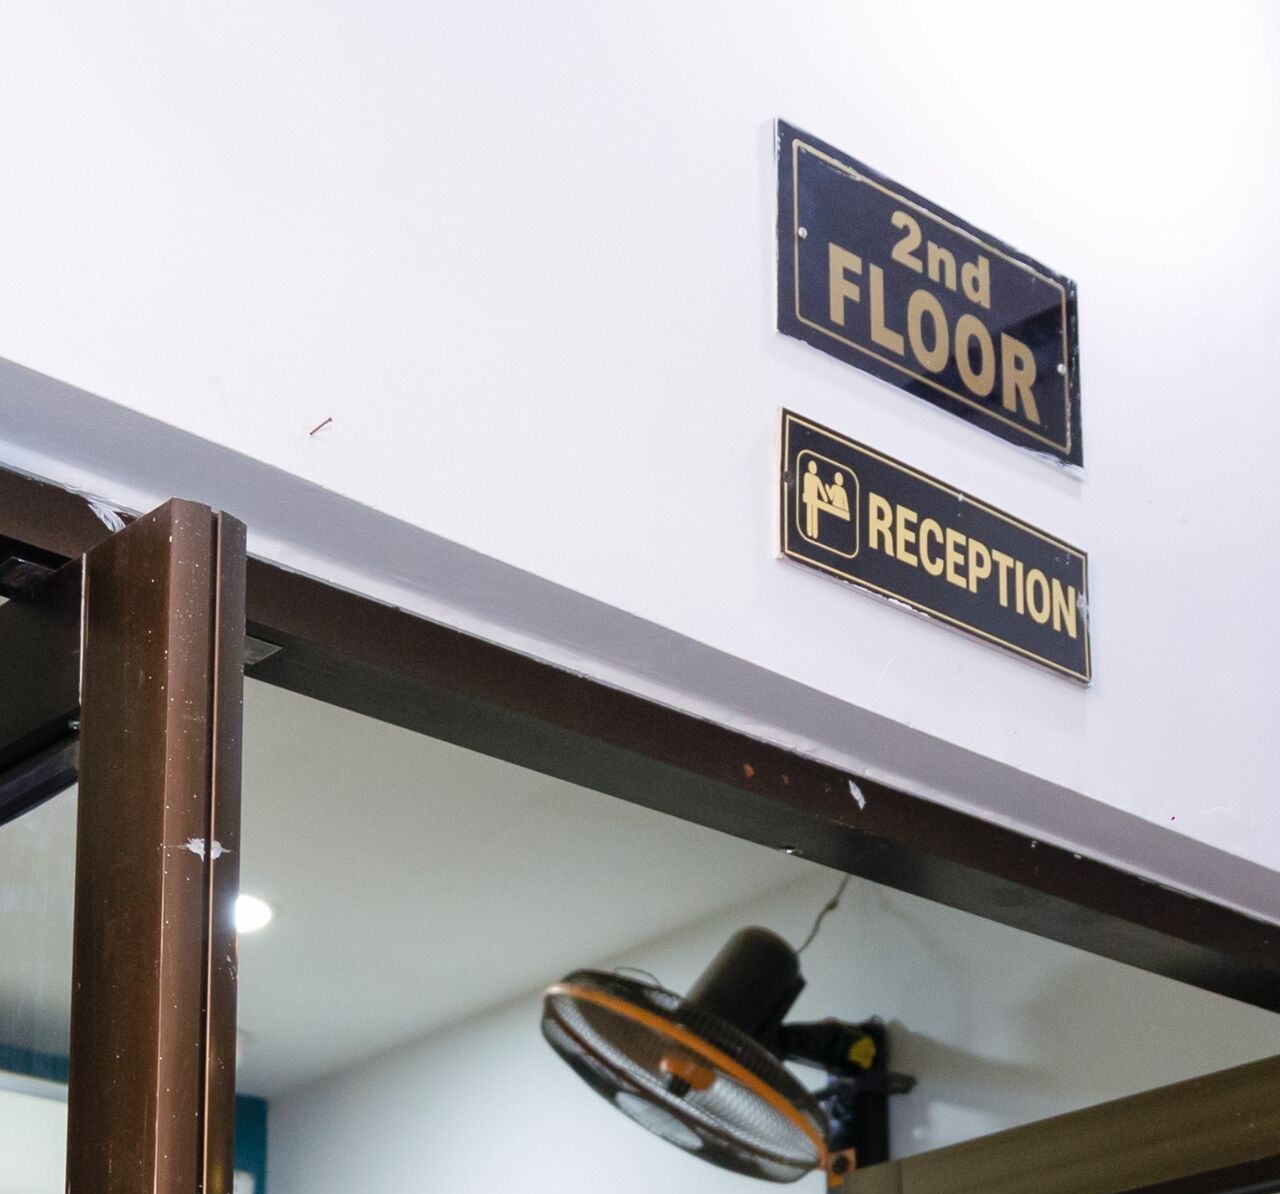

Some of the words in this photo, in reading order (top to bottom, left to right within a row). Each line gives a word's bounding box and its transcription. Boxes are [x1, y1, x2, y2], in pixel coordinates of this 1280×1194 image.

[828, 241, 1040, 425] FLOOR
[890, 210, 991, 308] 2nd
[868, 491, 1078, 639] RECEPTION
